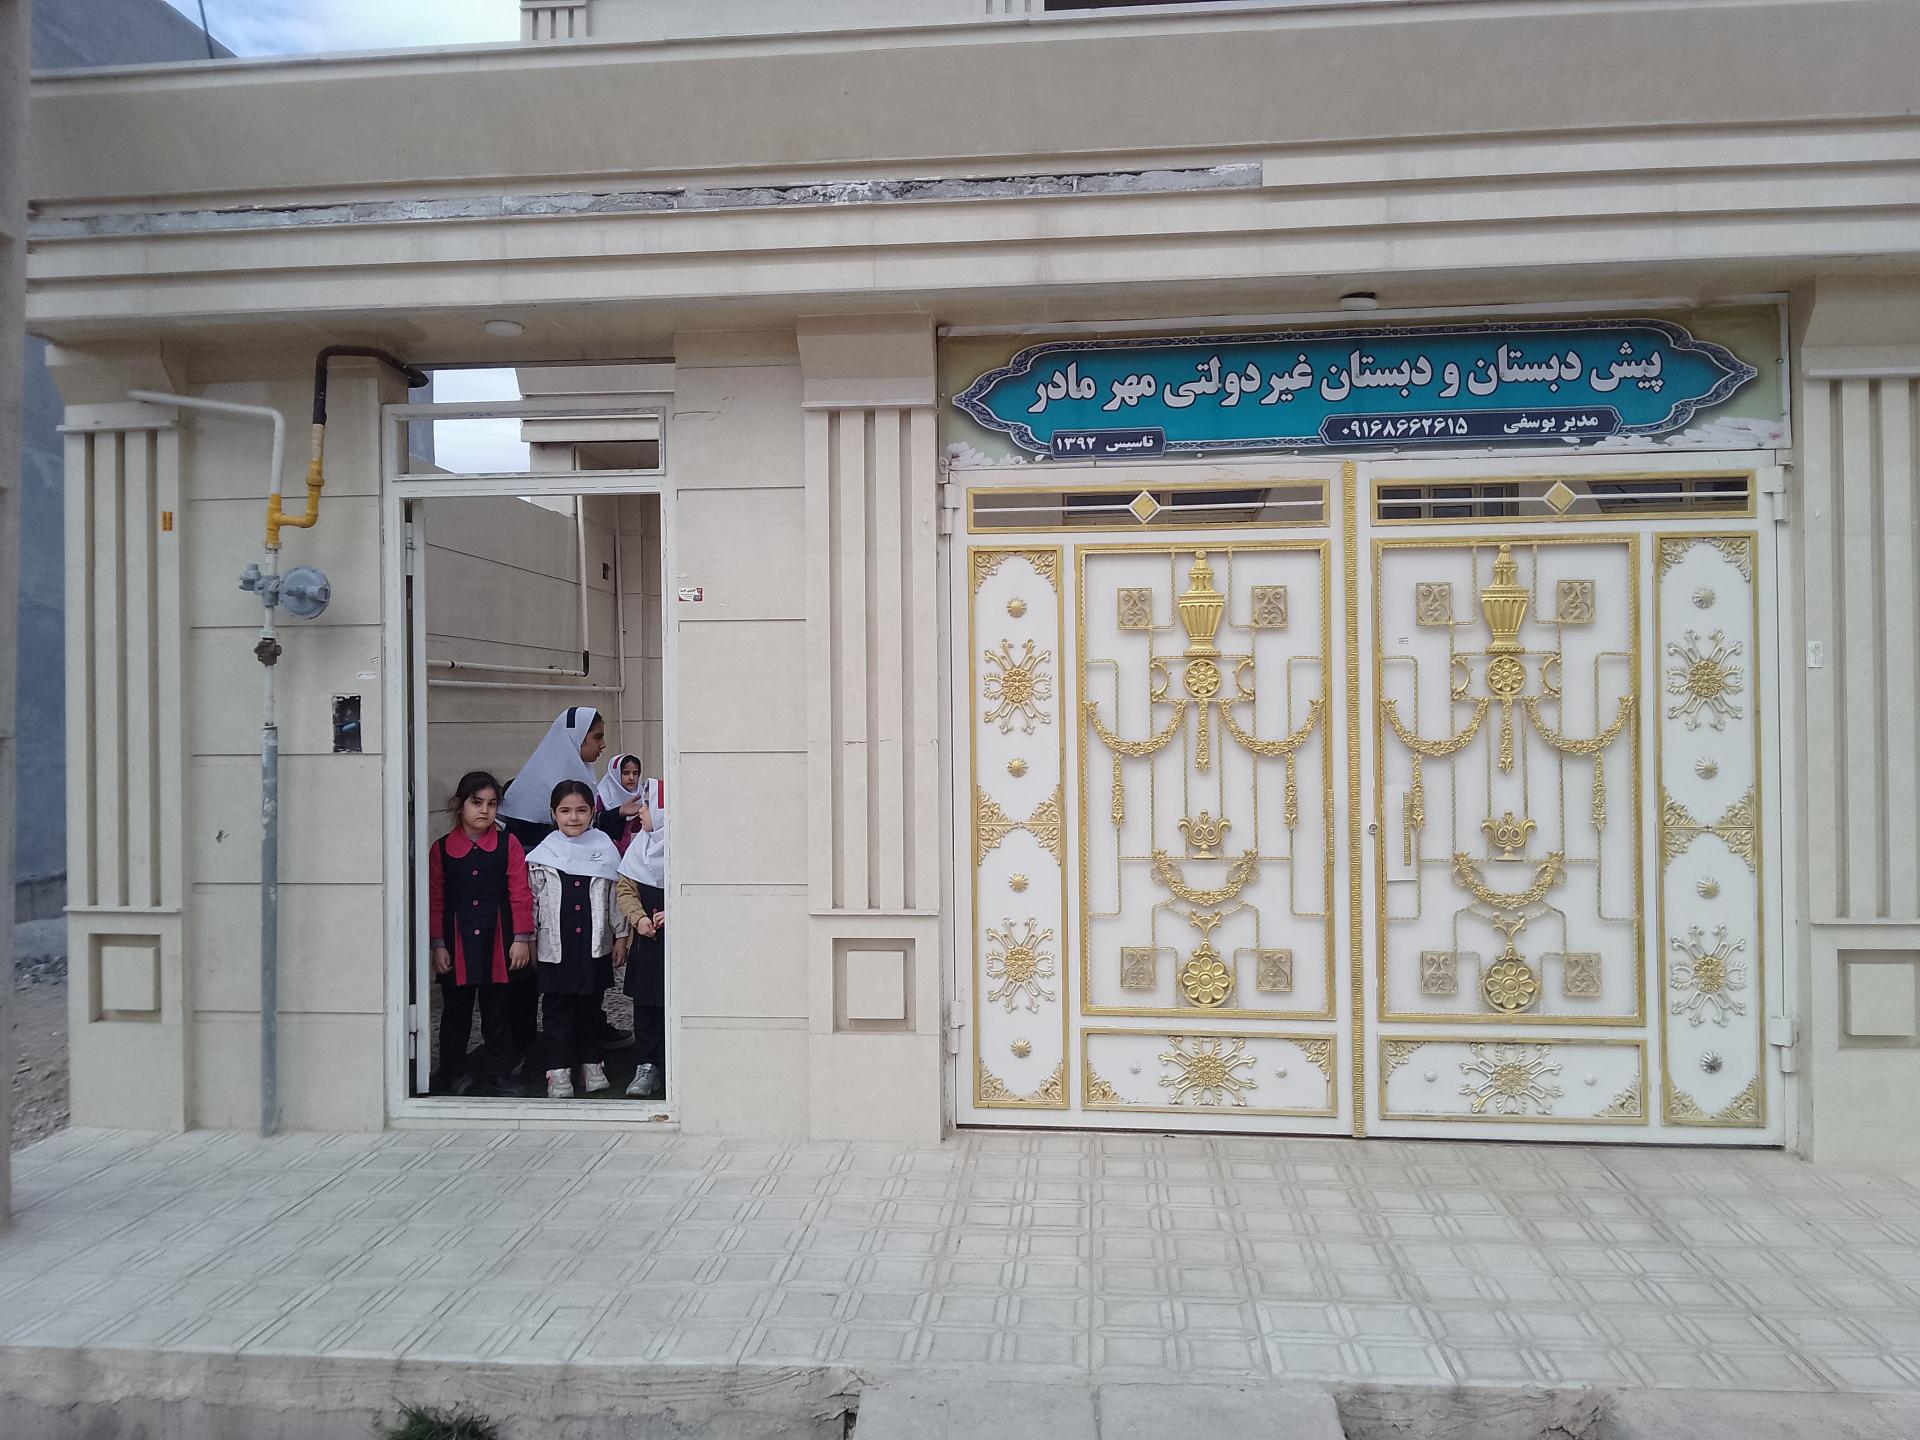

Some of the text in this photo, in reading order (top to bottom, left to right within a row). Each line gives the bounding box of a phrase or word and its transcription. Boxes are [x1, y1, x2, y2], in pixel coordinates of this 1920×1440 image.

[1028, 361, 1097, 413] مادر
[1320, 349, 1433, 402] دبستان
[1438, 362, 1461, 398] و
[1467, 343, 1582, 396] دبستان
[1589, 341, 1664, 393] پیش
[1102, 372, 1157, 411] مهر
[1056, 435, 1154, 452] تاسیس ۱۳۹۲
[1341, 413, 1599, 438] مدیر یوسفی ۰۹۱۶۸۶۶۲۶۱۵
